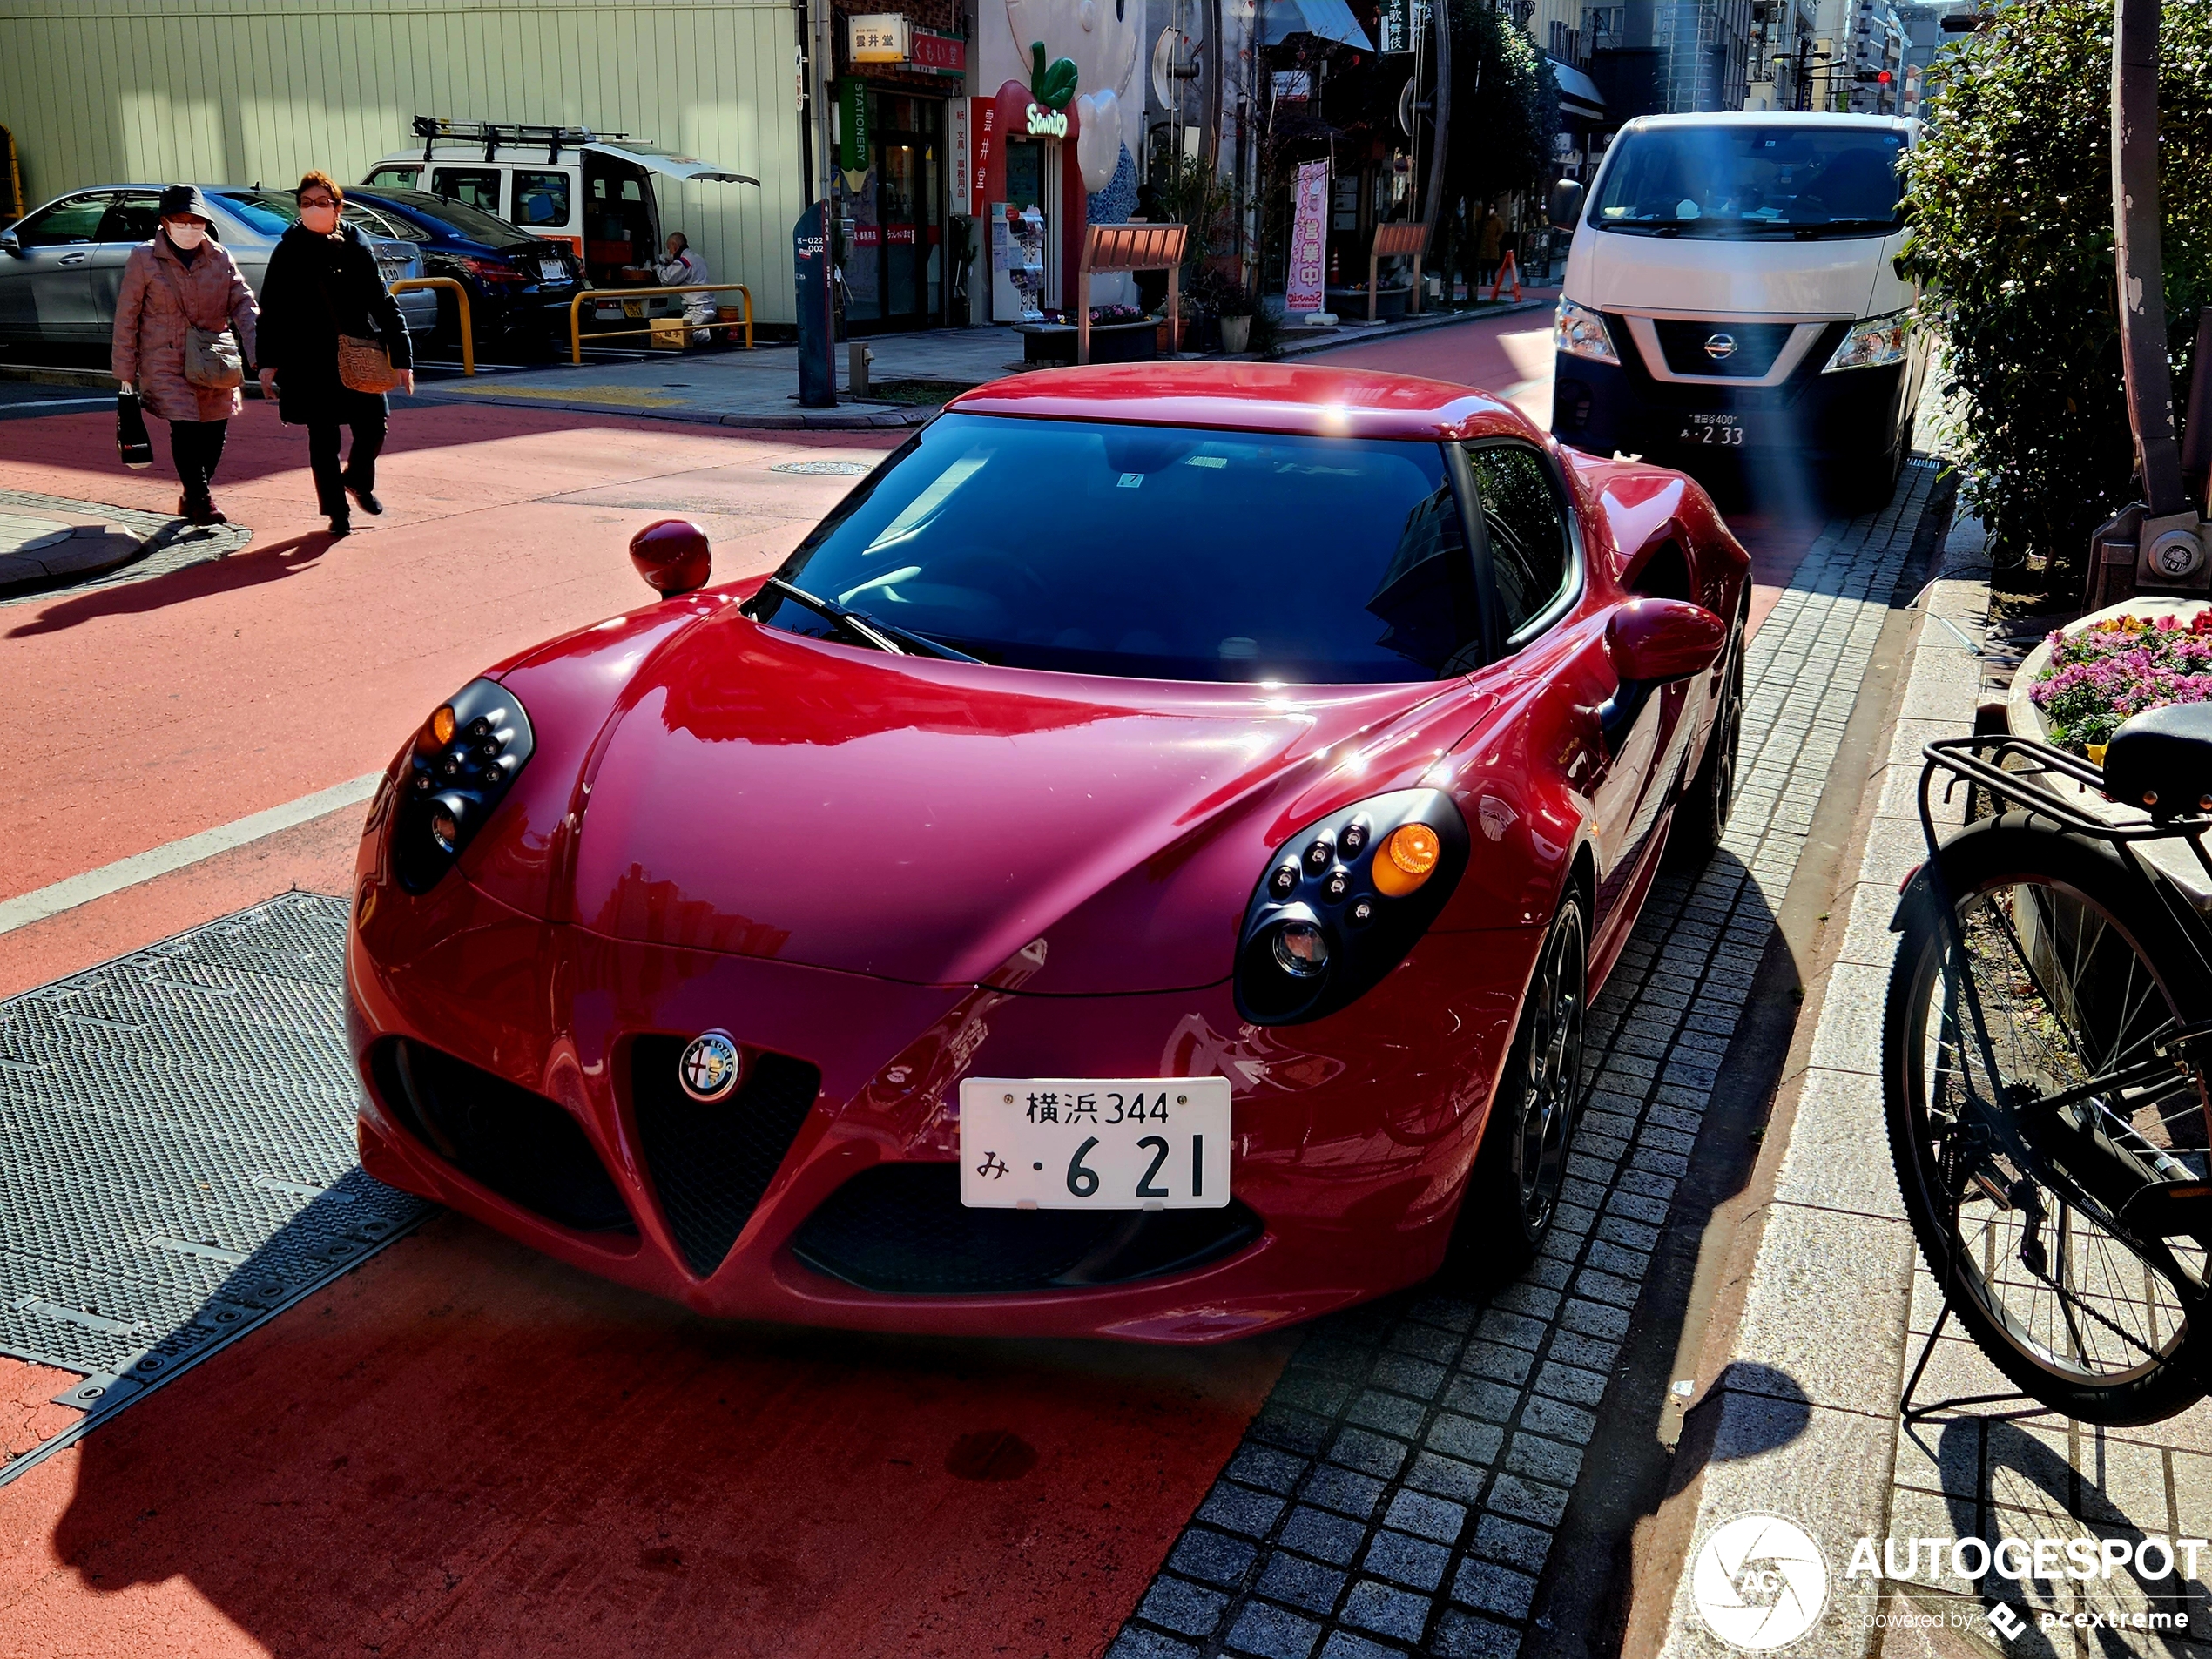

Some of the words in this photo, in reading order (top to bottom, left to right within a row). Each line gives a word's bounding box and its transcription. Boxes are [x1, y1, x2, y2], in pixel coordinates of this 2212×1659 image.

[855, 35, 894, 47] 雲井堂
[914, 40, 957, 65] くもい堂
[854, 83, 866, 162] STATIONERY
[1026, 103, 1068, 138] Sanrio
[976, 109, 994, 189] 雲井堂
[711, 1039, 733, 1073] ROMEO
[976, 1151, 1009, 1180] み
